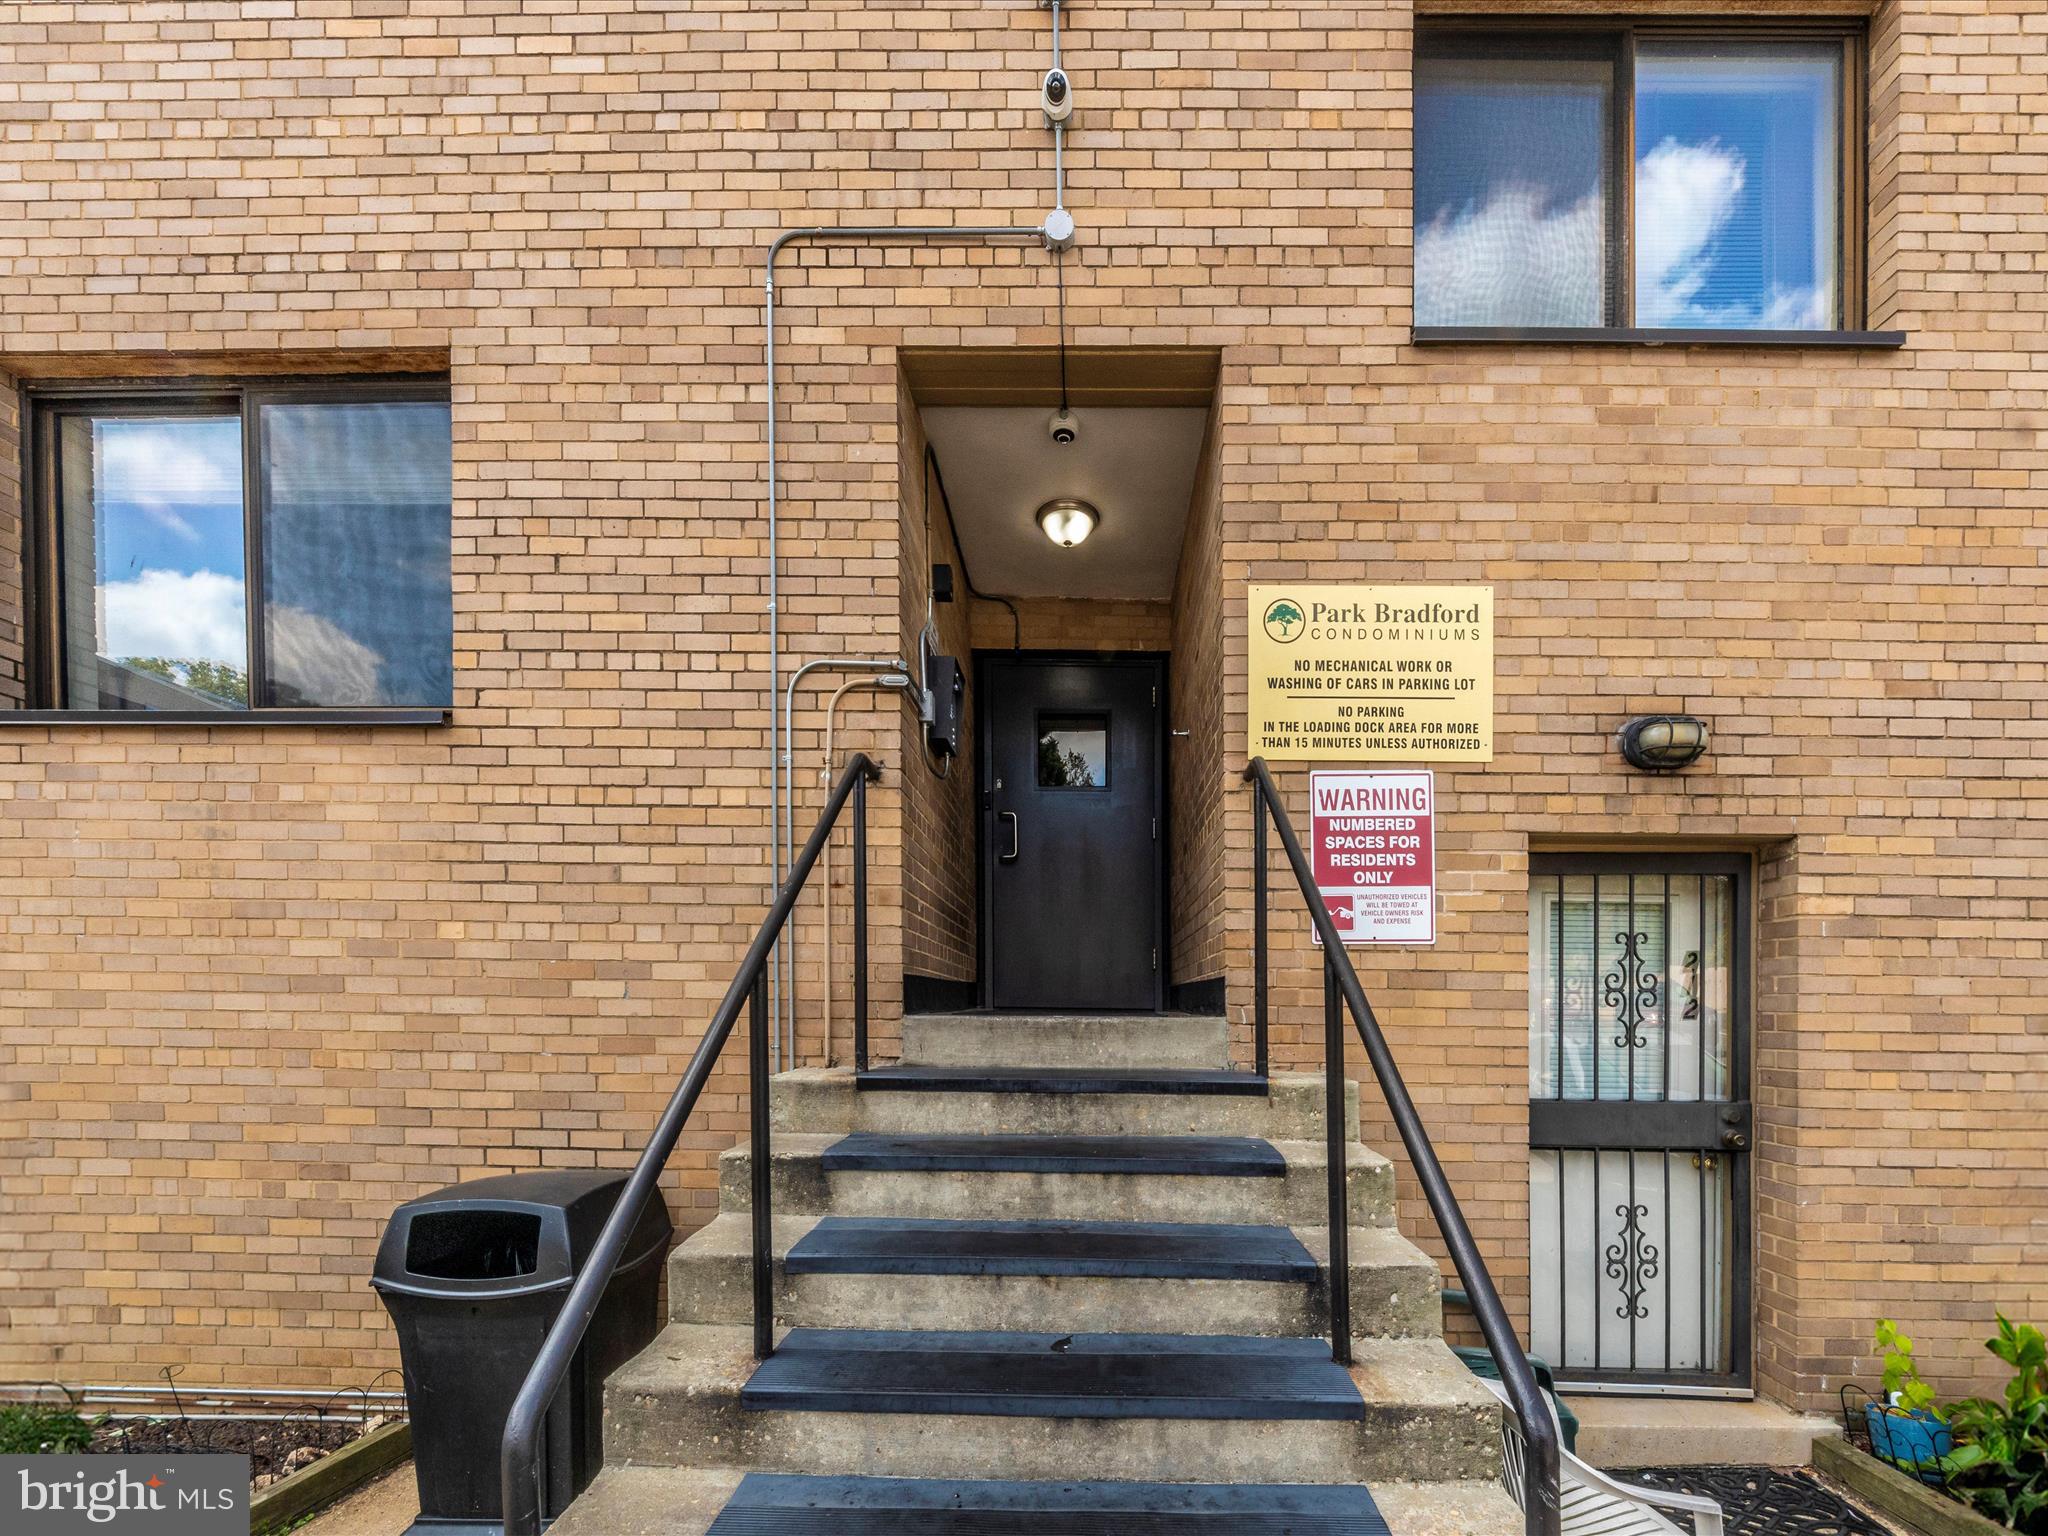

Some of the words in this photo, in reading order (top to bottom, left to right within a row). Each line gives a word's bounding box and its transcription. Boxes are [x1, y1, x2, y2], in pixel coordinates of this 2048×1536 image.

[1311, 602, 1366, 623] Park
[1375, 603, 1479, 623] Bradford
[1311, 628, 1480, 640] CONDOMINIUMS
[1294, 660, 1311, 672] NO
[1315, 660, 1393, 672] MECHANICAL
[1397, 661, 1432, 672] WORK
[1437, 661, 1452, 672] OR
[1267, 677, 1322, 689] WASHING
[1327, 678, 1342, 689] OF
[1346, 678, 1378, 690] CARS
[1382, 679, 1394, 690] IN
[1399, 679, 1449, 690] PARKING
[1455, 679, 1475, 690] LOT
[1338, 706, 1353, 717] NO
[1357, 707, 1404, 717] PARKING
[1264, 721, 1274, 732] IN
[1279, 722, 1299, 732] THE
[1304, 722, 1350, 733] LOADING
[1355, 722, 1384, 733] DOCK
[1388, 722, 1416, 733] AREA
[1421, 723, 1442, 733] FOR
[1447, 723, 1479, 734] MORE
[1262, 737, 1290, 748] THAN
[1296, 737, 1308, 748] 15
[1312, 737, 1361, 748] MINUTES
[1366, 738, 1407, 749] UNLESS
[1411, 738, 1480, 749] AUTHORIZED
[1318, 788, 1426, 811] WARNING
[1330, 819, 1415, 831] NUMBERED
[1325, 836, 1385, 849] SPACES
[1390, 836, 1420, 848] FOR
[1331, 854, 1416, 866] RESIDENTS
[1354, 871, 1393, 884] ONLY
